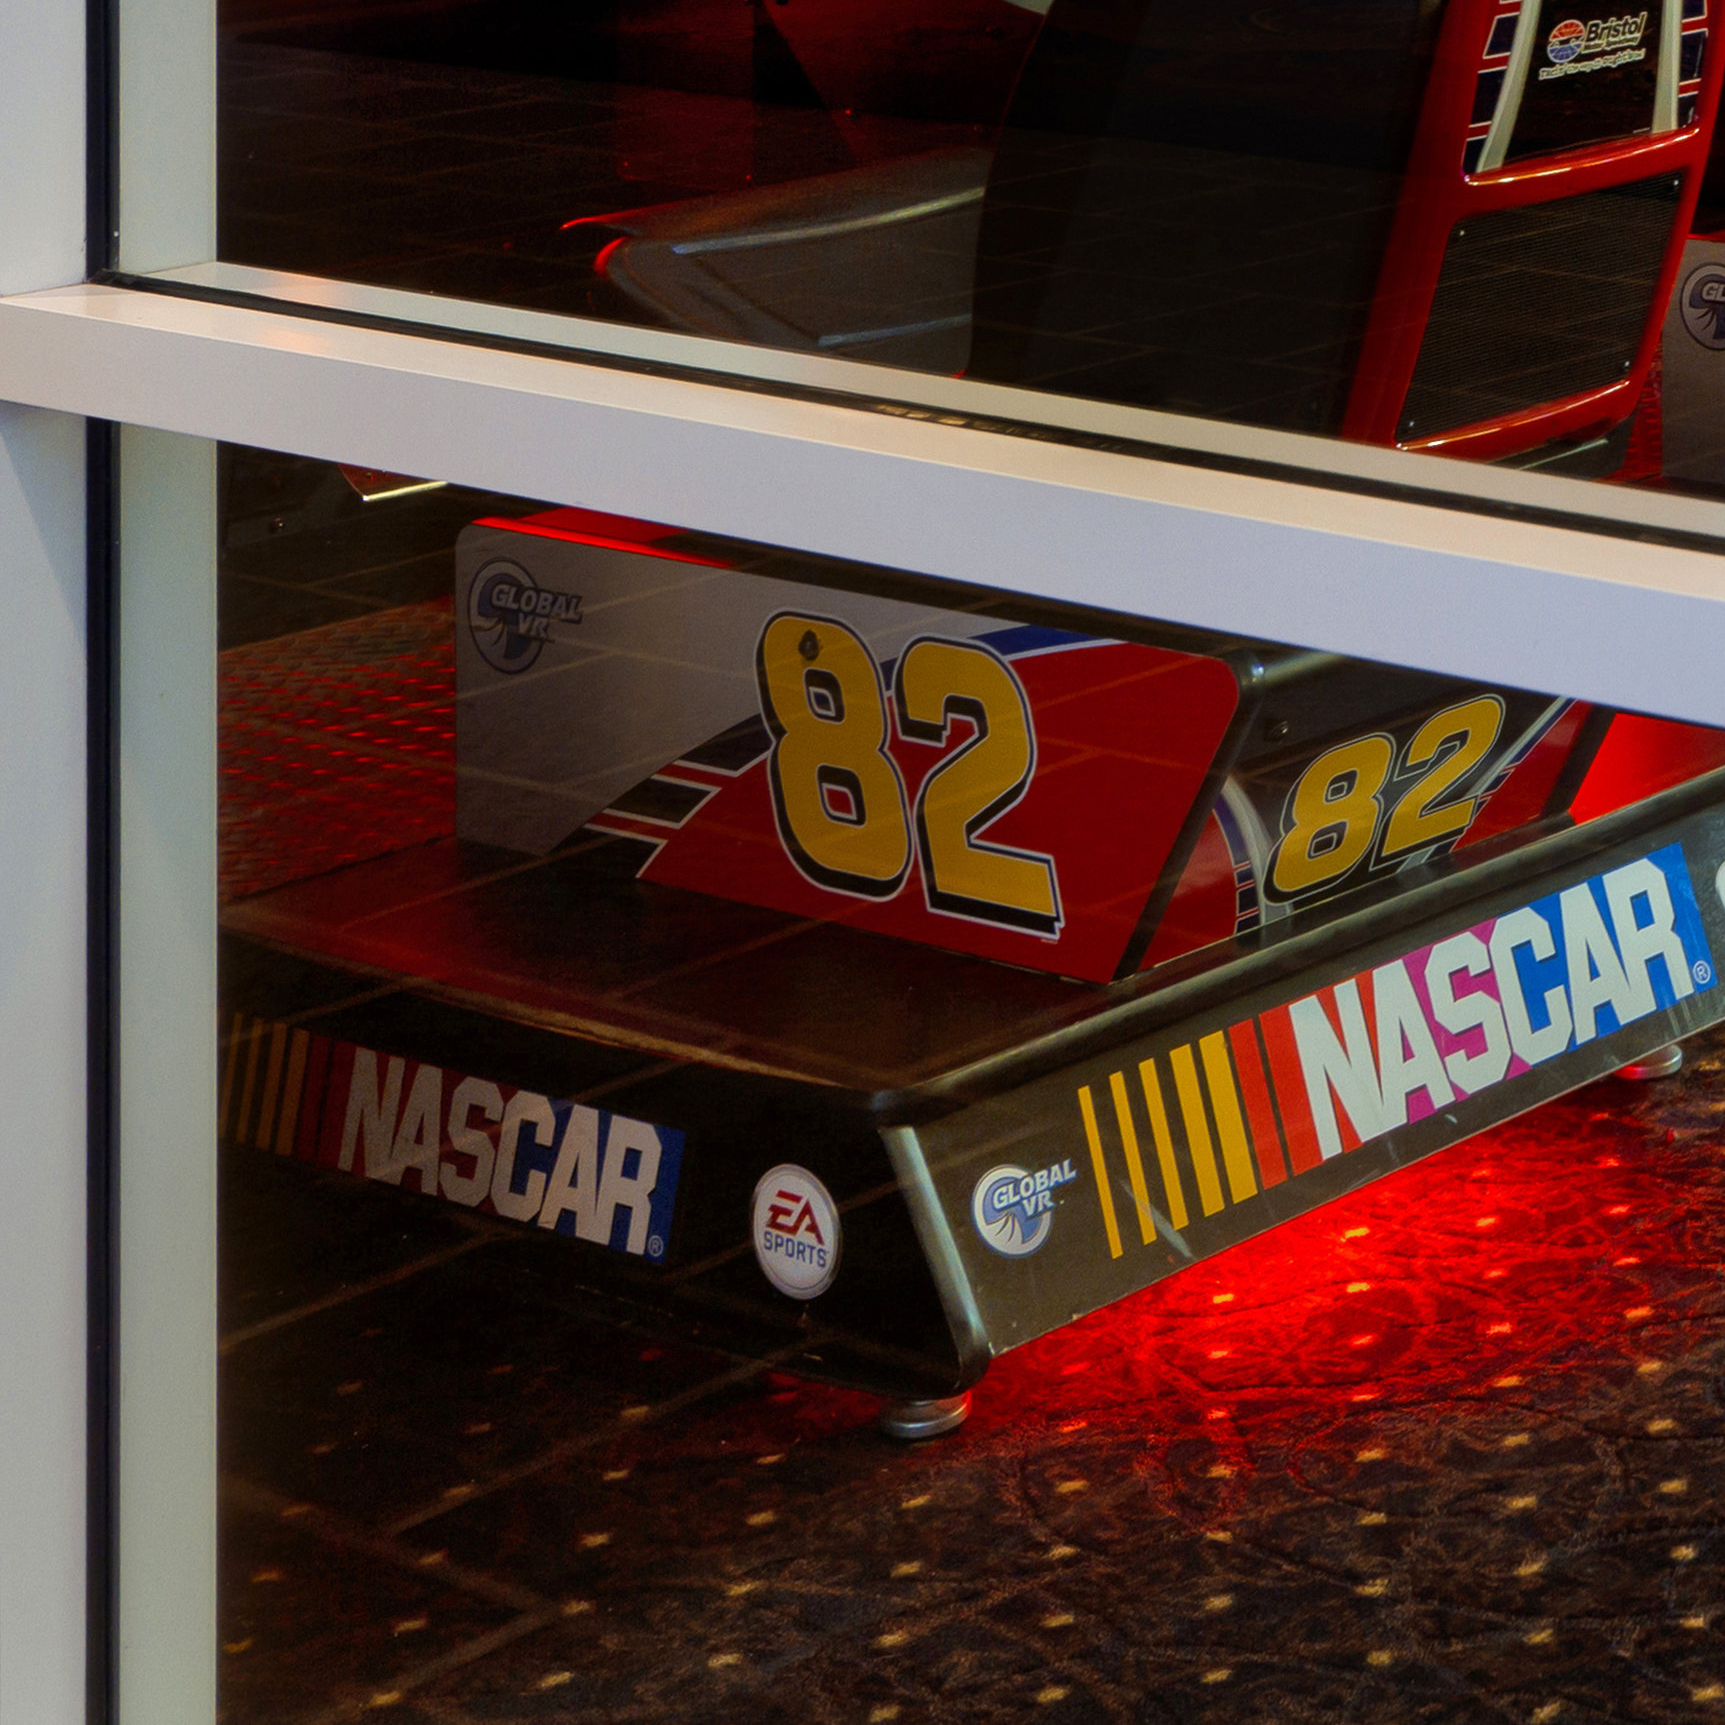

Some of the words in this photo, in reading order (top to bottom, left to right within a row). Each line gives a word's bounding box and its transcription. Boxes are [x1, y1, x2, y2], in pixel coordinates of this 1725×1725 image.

[1585, 13, 1648, 43] Bristol
[490, 582, 583, 625] GLOBAL
[517, 612, 554, 643] VR
[755, 609, 1064, 940] 82
[1266, 694, 1505, 904] 82
[1288, 858, 1695, 1160] NASCAR
[337, 1047, 663, 1256] NASCAR
[991, 1159, 1077, 1210] GLOBAL
[1020, 1186, 1057, 1215] VR
[765, 1188, 825, 1245] EA
[763, 1230, 828, 1269] SPORTS
